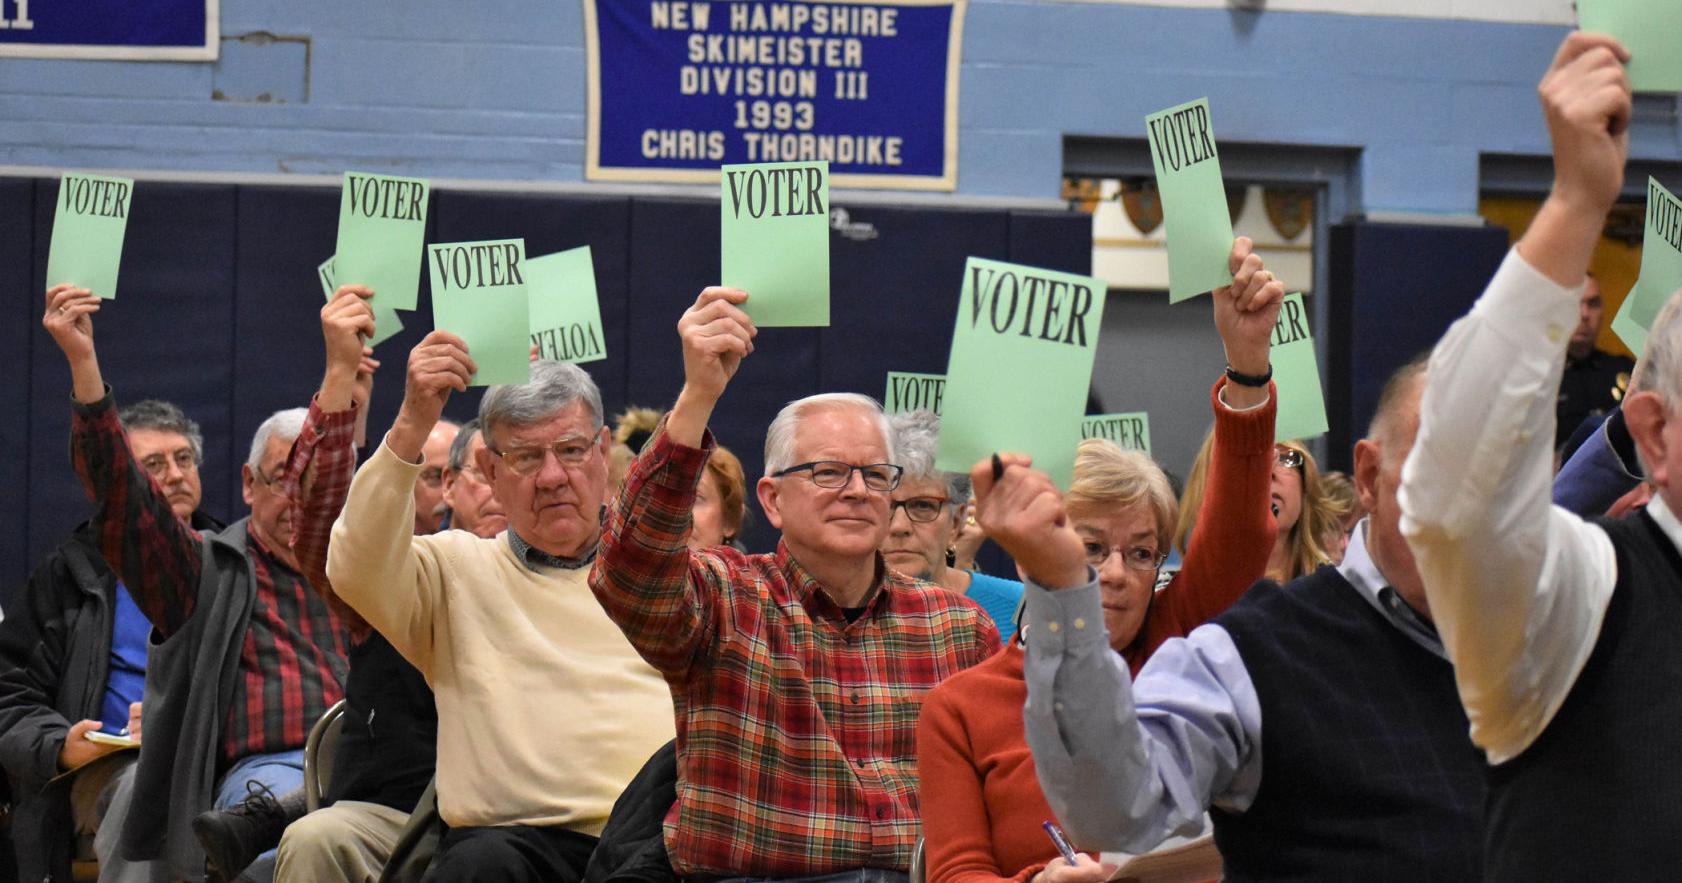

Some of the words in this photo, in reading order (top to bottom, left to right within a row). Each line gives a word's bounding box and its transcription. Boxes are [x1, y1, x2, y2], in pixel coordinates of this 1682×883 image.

[651, 1, 710, 30] NEW
[730, 4, 898, 36] HAMPSHIRE
[688, 33, 862, 67] SKIMEISTER
[681, 66, 816, 97] DIVISION
[835, 71, 868, 99] III
[735, 100, 814, 130] 1993
[642, 129, 725, 160] CHRIS
[744, 132, 903, 165] THORNDIKE
[1149, 104, 1215, 174] VOTER
[65, 176, 128, 219] VOTER
[349, 176, 424, 221] VOTER
[727, 167, 825, 219] VOTER
[1650, 184, 1682, 253] VOTE
[433, 243, 524, 290] VOTER
[971, 266, 1093, 347] VOTER
[892, 377, 946, 417] VOTE
[1081, 418, 1146, 451] VOTER
